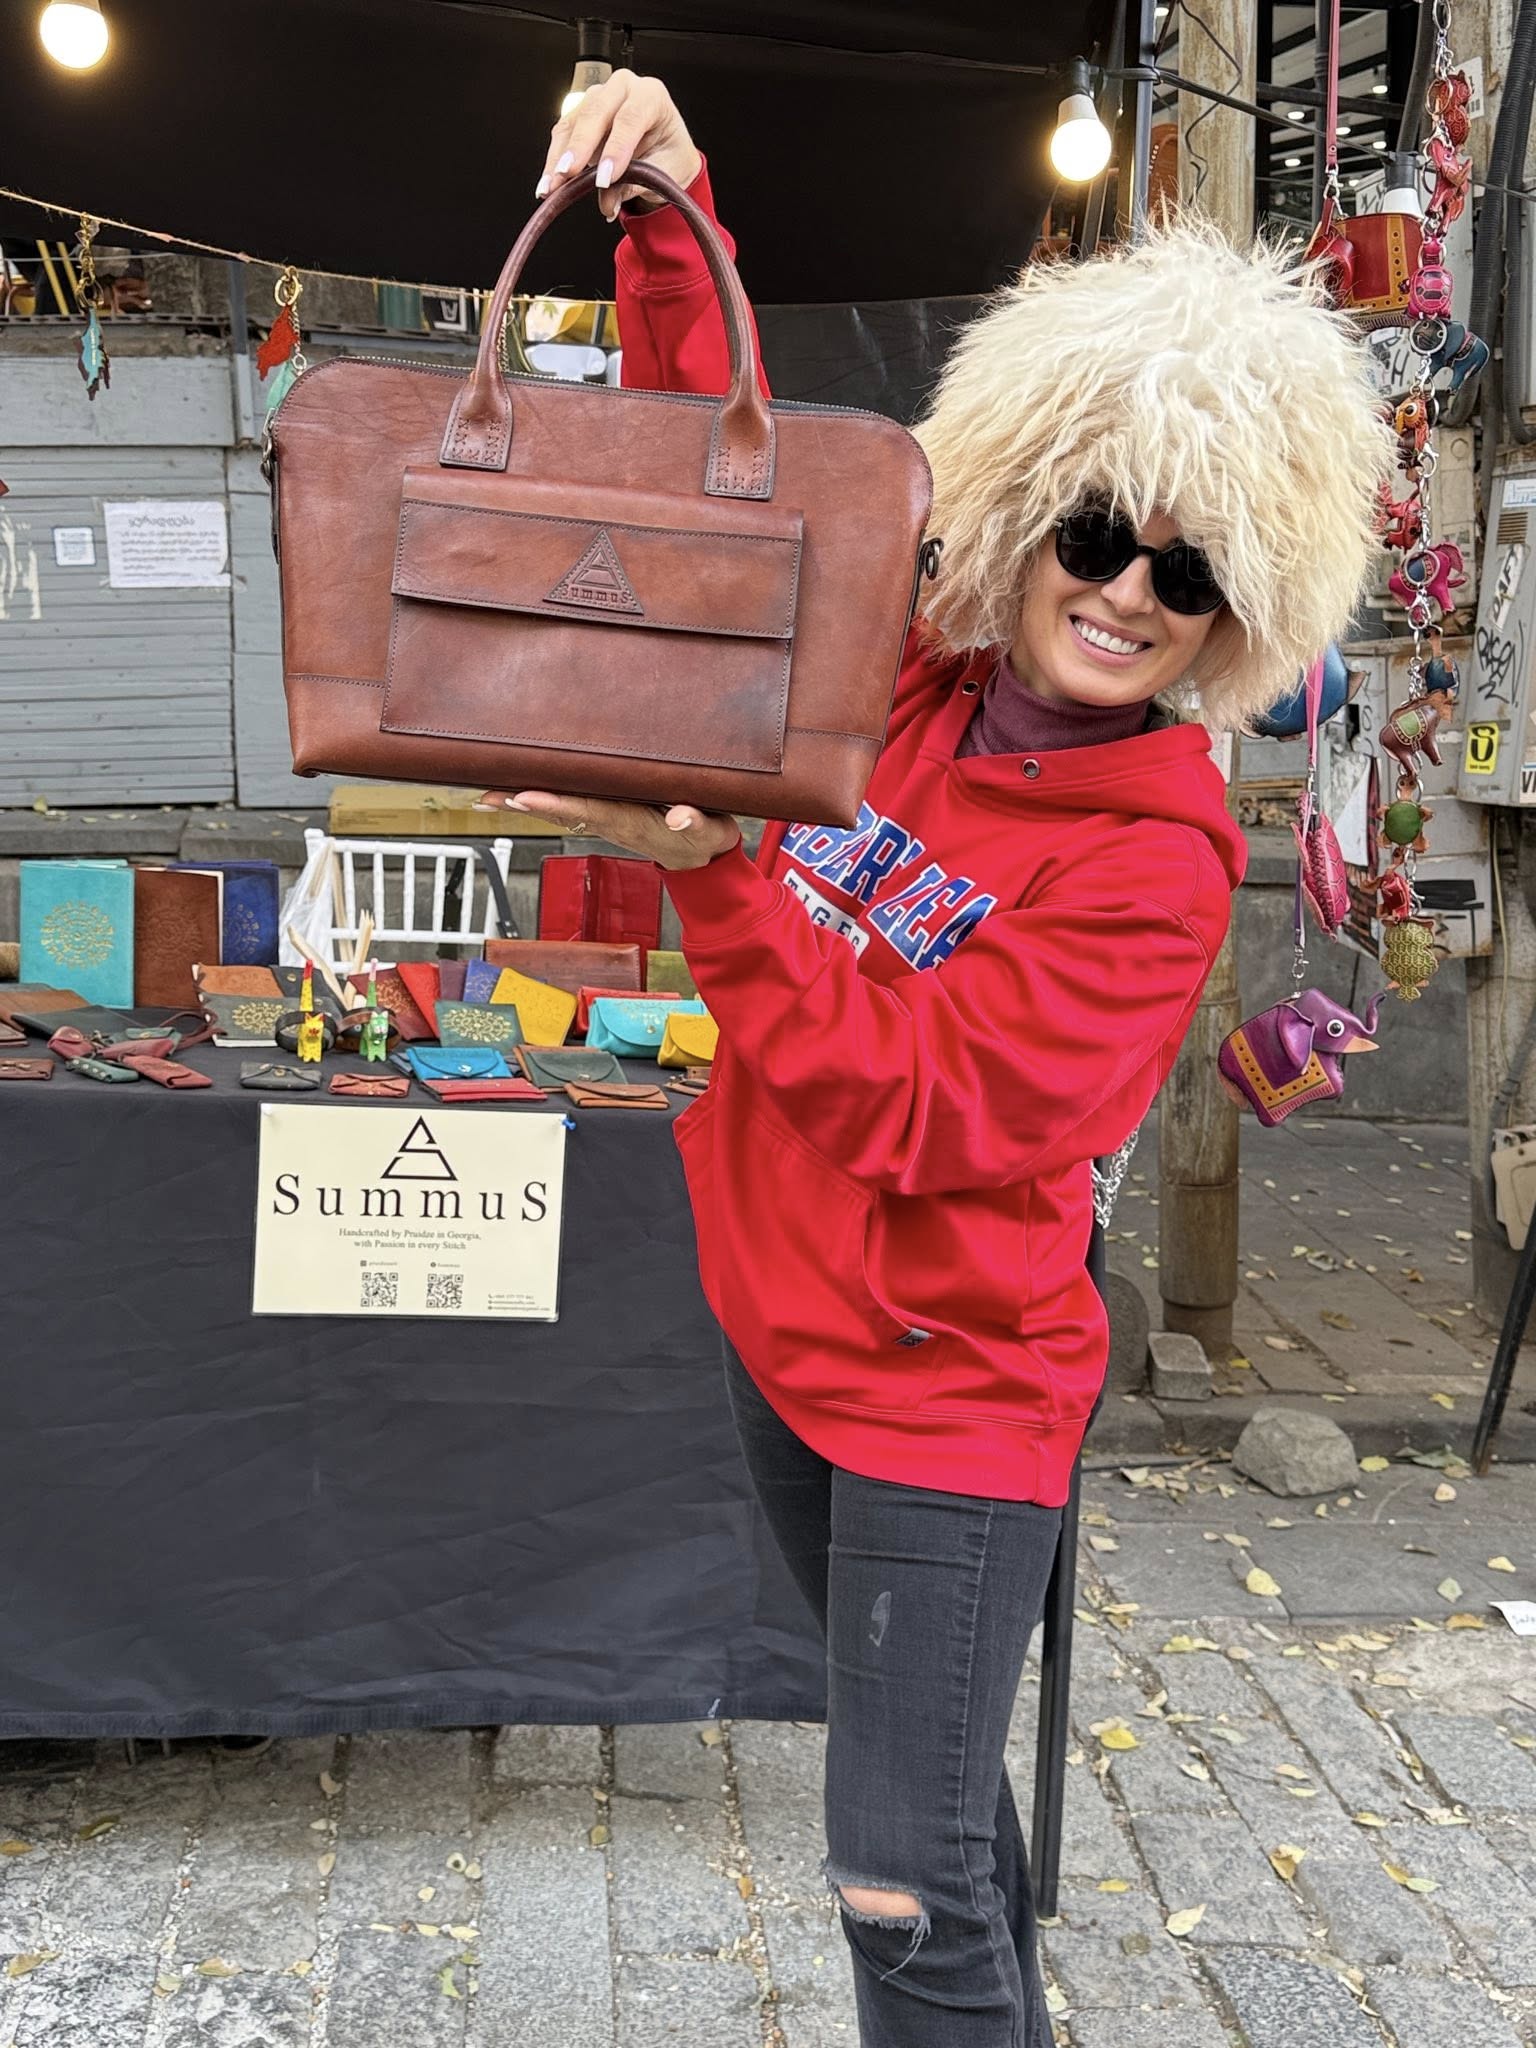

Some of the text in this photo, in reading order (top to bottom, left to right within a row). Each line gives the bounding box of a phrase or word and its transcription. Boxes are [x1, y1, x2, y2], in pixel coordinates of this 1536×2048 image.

[273, 1173, 548, 1222] SummuS
[339, 1228, 389, 1238] Handcrafted
[391, 1229, 401, 1240] by
[437, 1230, 445, 1239] in
[447, 1231, 481, 1241] Georgia,
[354, 1239, 466, 1251] with Passion in every Stitch
